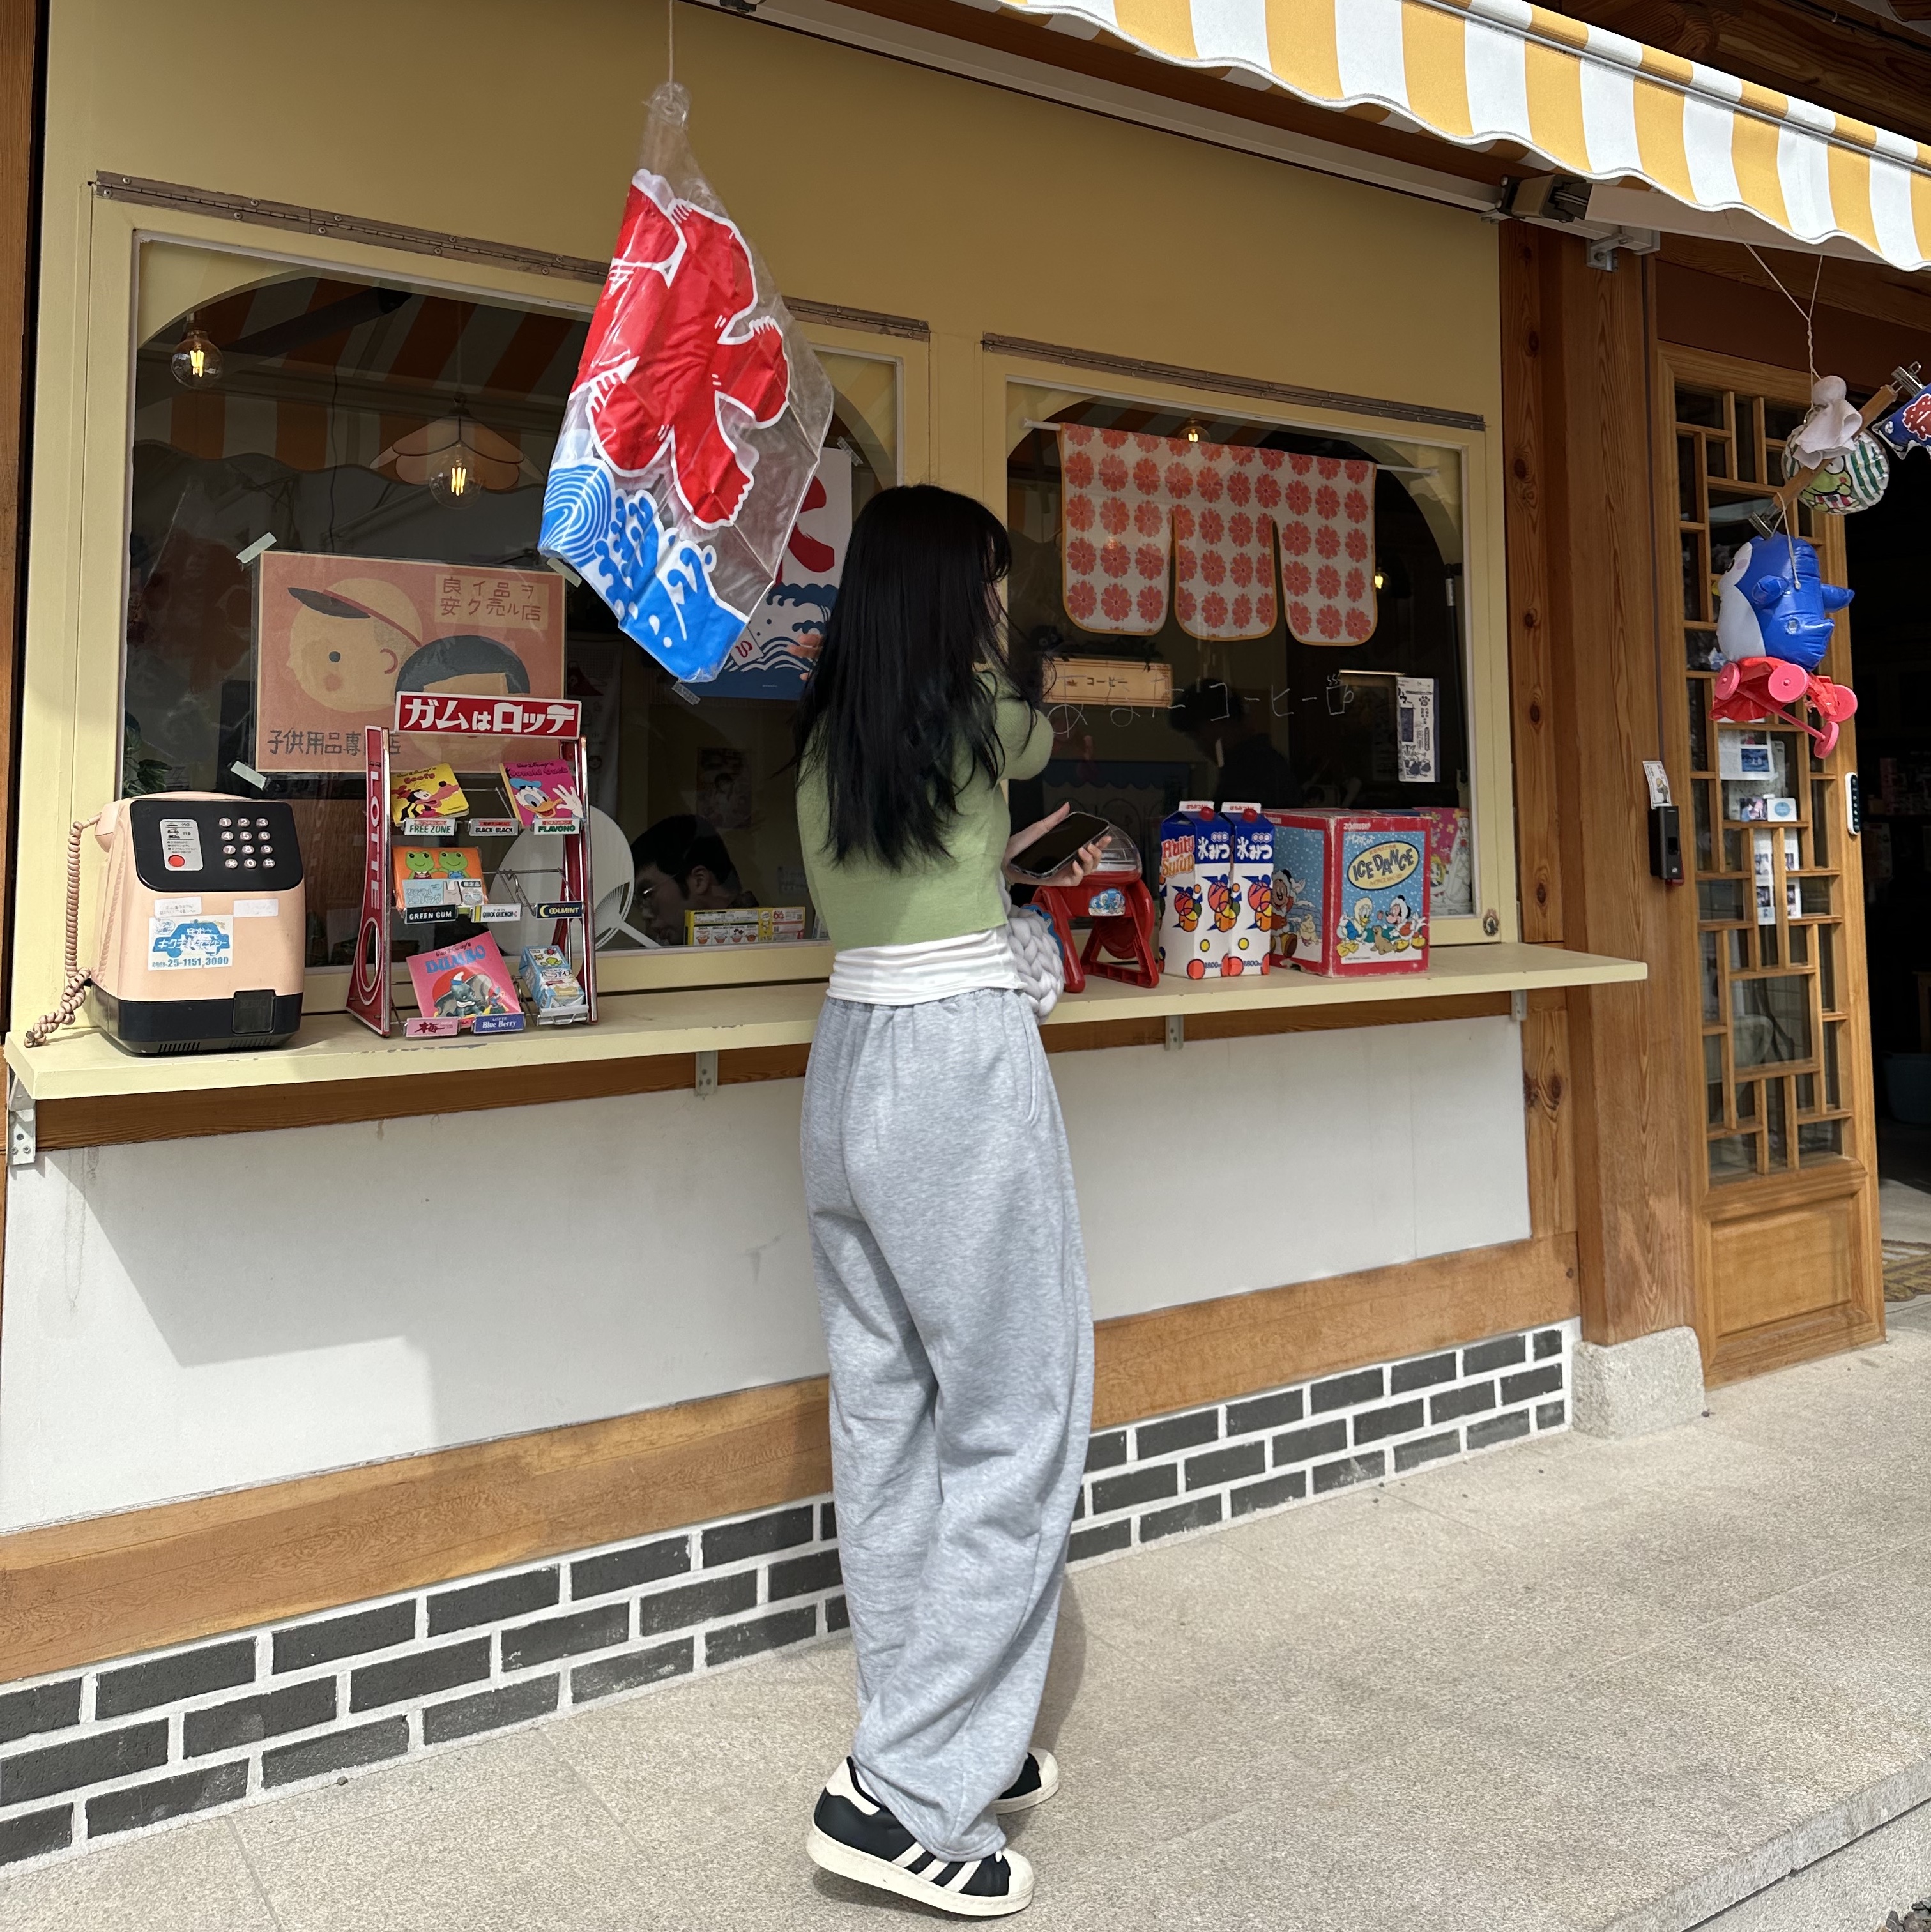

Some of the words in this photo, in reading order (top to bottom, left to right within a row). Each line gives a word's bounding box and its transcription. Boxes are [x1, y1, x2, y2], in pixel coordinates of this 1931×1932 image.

[443, 576, 535, 599] 良イ品ヲ
[440, 597, 542, 621] 安ク売ル店
[404, 698, 576, 734] ガムはロッテ
[267, 727, 401, 756] 子供用品専店
[404, 773, 436, 784] Goofy
[370, 770, 380, 911] LOTTE
[409, 825, 429, 833] FREE
[431, 825, 452, 833] ZONE
[538, 825, 576, 833] FLAVONO
[1161, 835, 1195, 859] Fruity
[1198, 835, 1231, 860] 氷みつ
[1237, 836, 1273, 860] 氷みつ
[1161, 853, 1195, 878] Syrup
[1352, 860, 1375, 881] ICE
[1372, 848, 1414, 876] DANCE
[409, 912, 434, 920] GREEN
[425, 944, 485, 974] DUMBO
[482, 1020, 497, 1029] Blue
[498, 1019, 517, 1029] Berry
